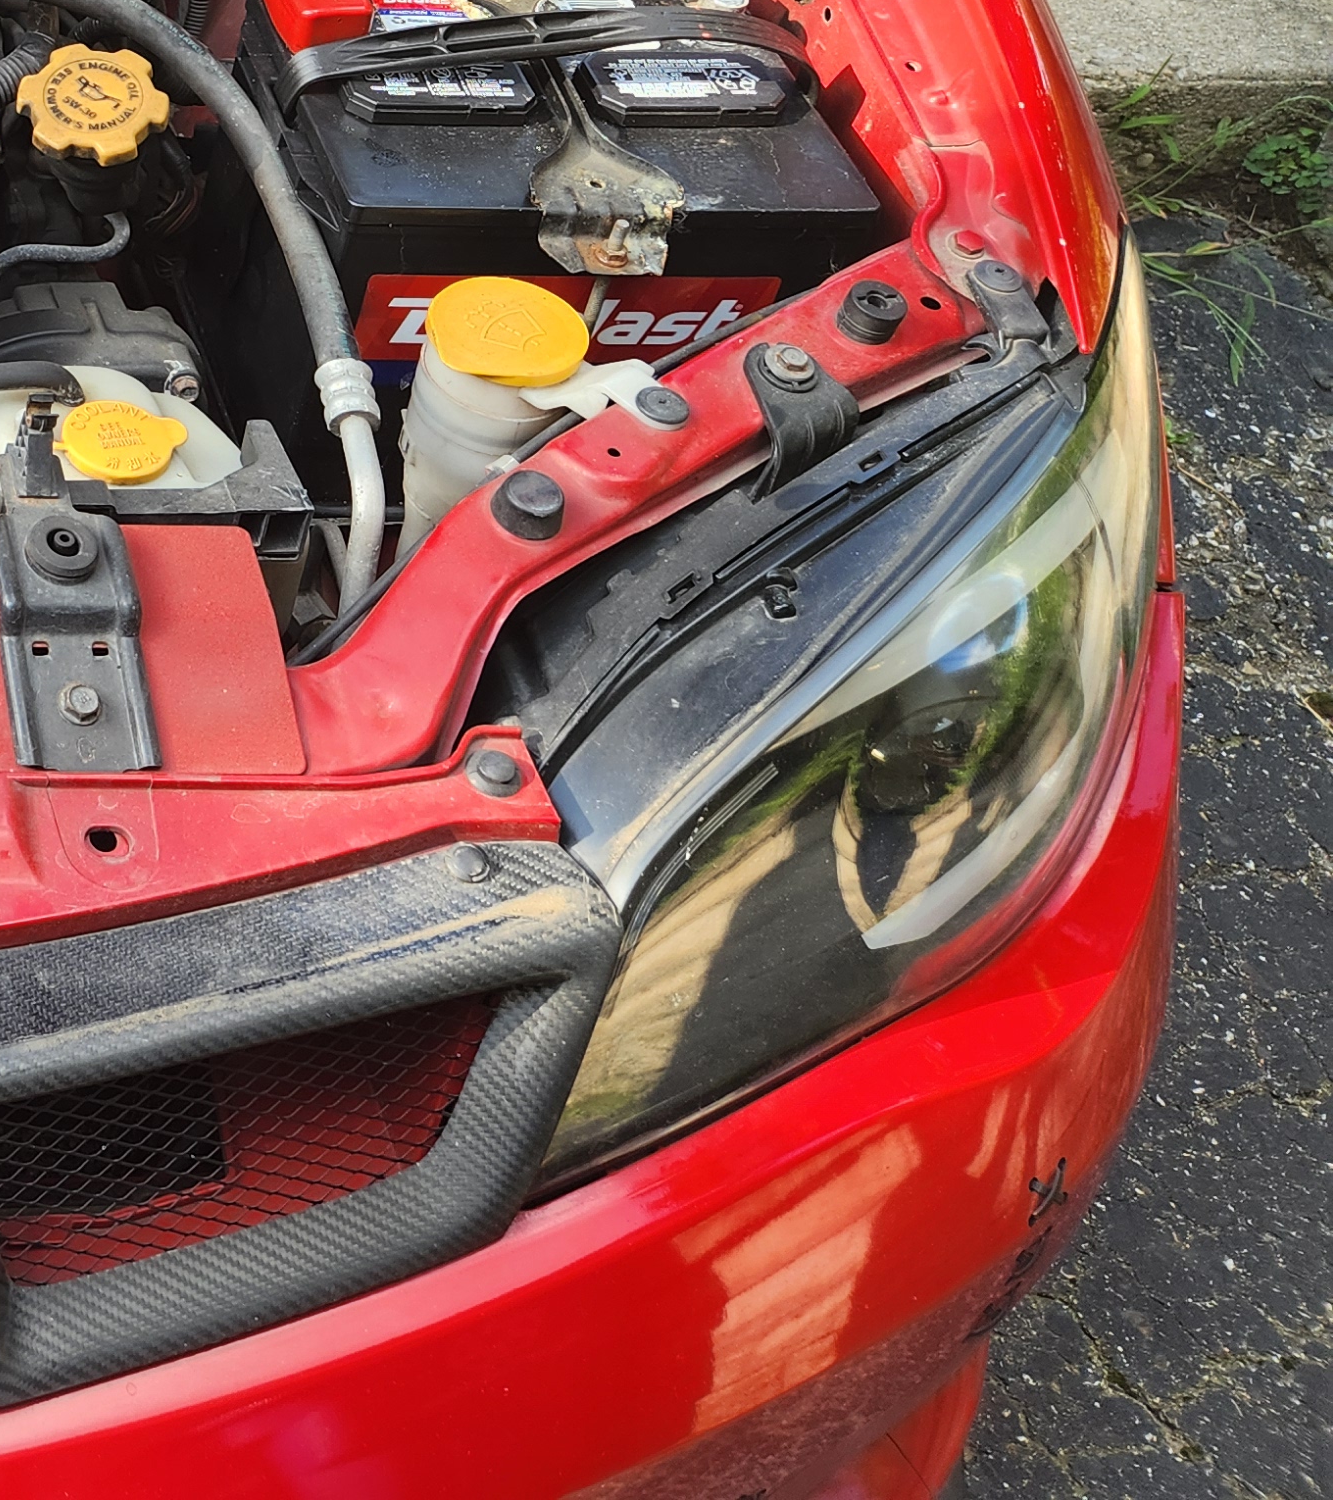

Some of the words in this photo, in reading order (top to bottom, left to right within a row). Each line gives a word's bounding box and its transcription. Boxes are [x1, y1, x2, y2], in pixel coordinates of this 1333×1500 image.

[78, 61, 131, 81] ENGINE
[126, 81, 140, 101] OIL
[50, 67, 73, 86] SEE
[88, 106, 137, 131] MANUAL
[62, 95, 98, 119] 5W-30
[70, 401, 153, 431] COOLANT
